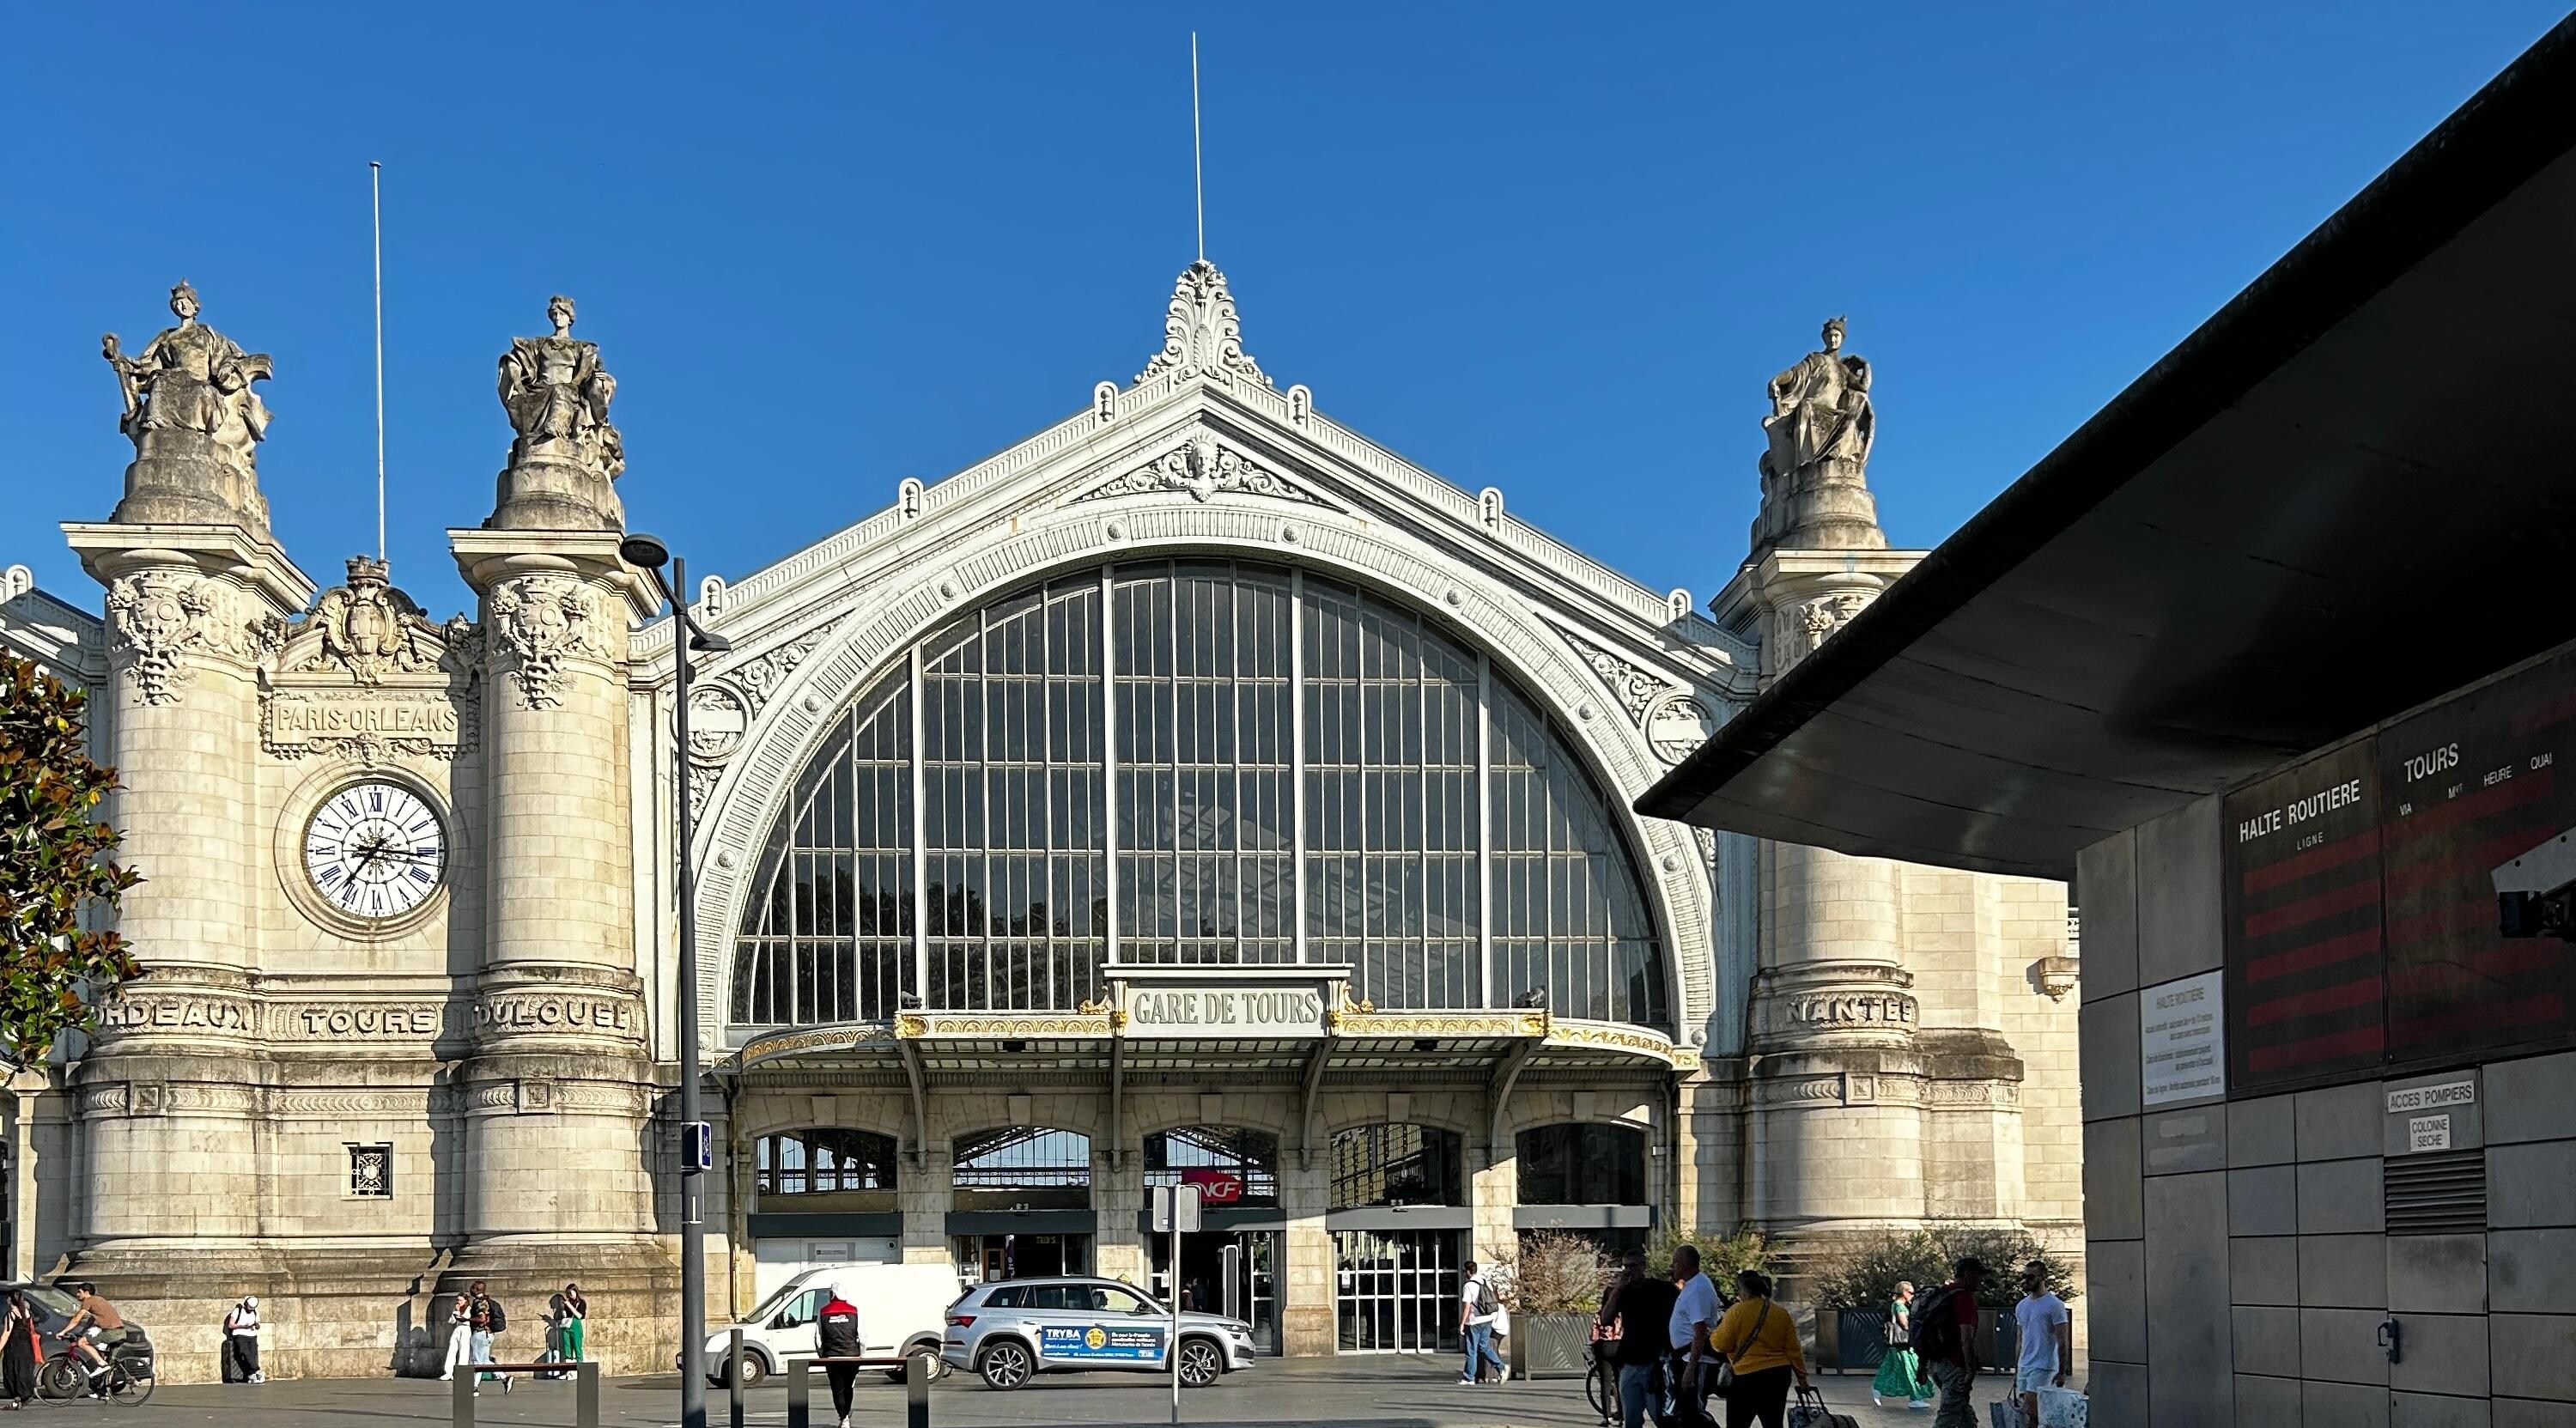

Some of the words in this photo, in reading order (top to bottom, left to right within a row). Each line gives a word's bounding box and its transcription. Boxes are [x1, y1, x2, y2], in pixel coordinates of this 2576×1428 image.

[2403, 742, 2460, 783] TOURS
[2530, 751, 2553, 771] QUAI
[2483, 765, 2512, 787] HEURE
[2239, 809, 2282, 843] HALTE
[2287, 779, 2361, 825] ROUTIERE
[2399, 802, 2412, 817] VIA
[2296, 831, 2324, 851] LIGNE
[1134, 992, 1199, 1024] GARE
[1204, 993, 1236, 1024] DE
[1242, 992, 1319, 1024] TOURS
[1785, 997, 1912, 1024] NANTES
[301, 1008, 438, 1035] TOURS
[2390, 1091, 2421, 1109] ACCES
[2425, 1085, 2472, 1105] POMPIERS
[2411, 1119, 2448, 1134] COLONNE
[2417, 1134, 2443, 1147] SECHE
[1045, 1328, 1081, 1338] TRYBA
